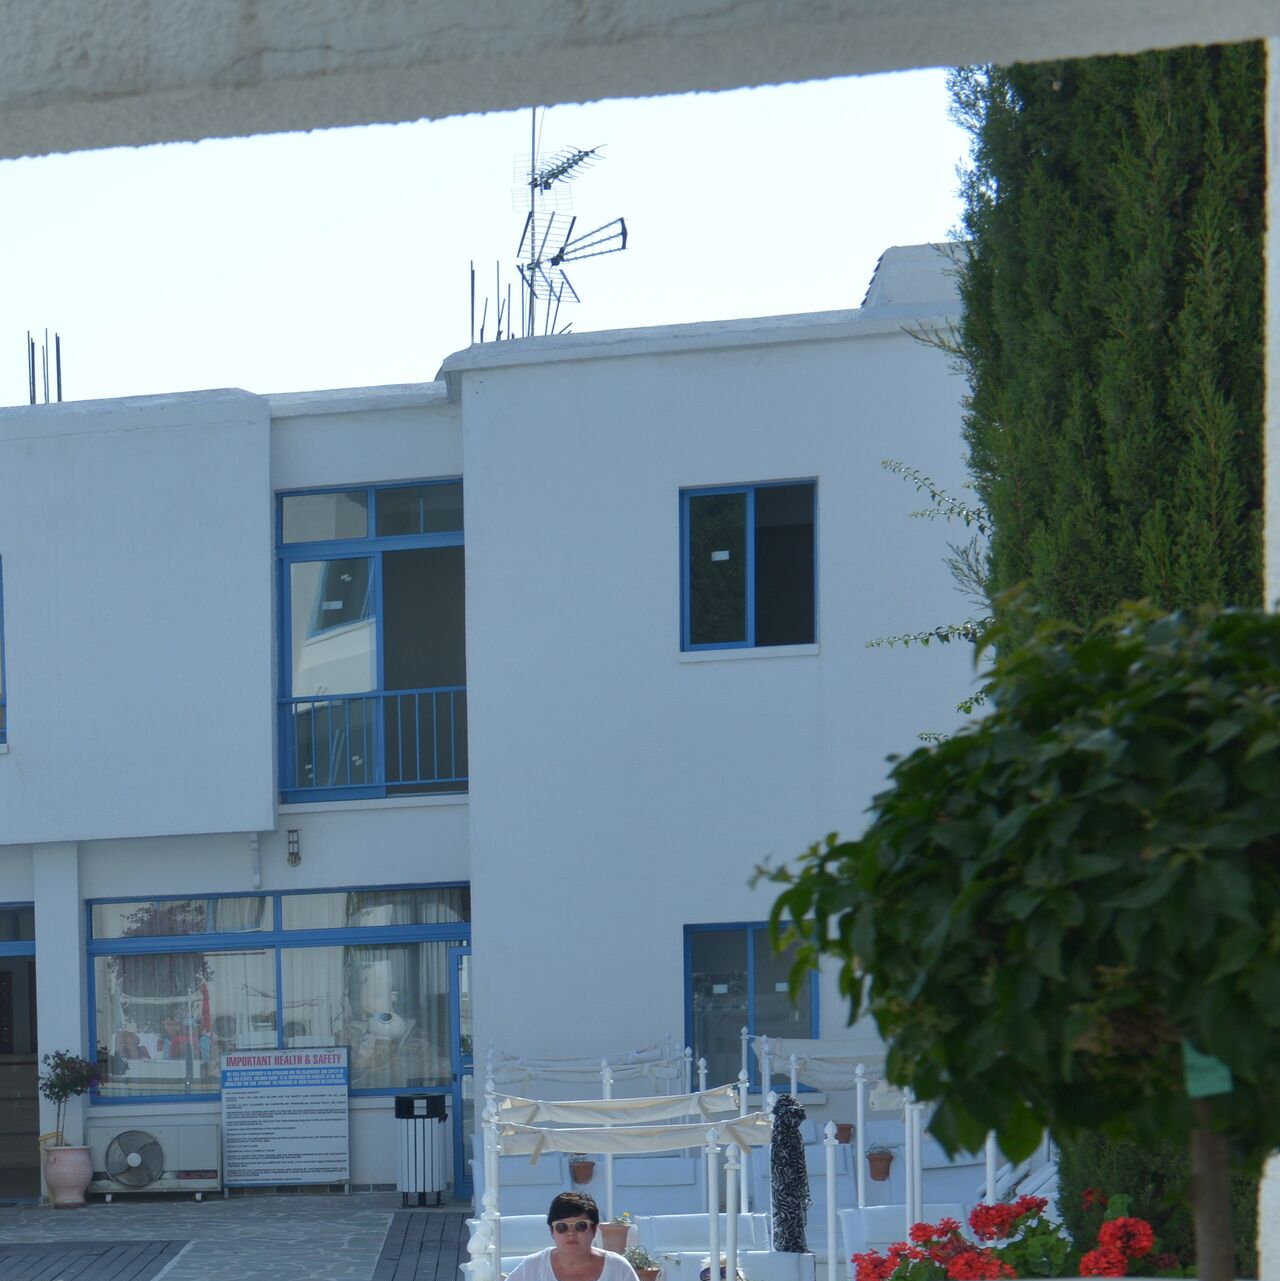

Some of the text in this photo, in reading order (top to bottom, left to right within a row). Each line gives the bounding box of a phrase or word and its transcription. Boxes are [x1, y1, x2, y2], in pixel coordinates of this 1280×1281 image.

[226, 1054, 341, 1067] IMPORTANT HEALTH & SAFETY
